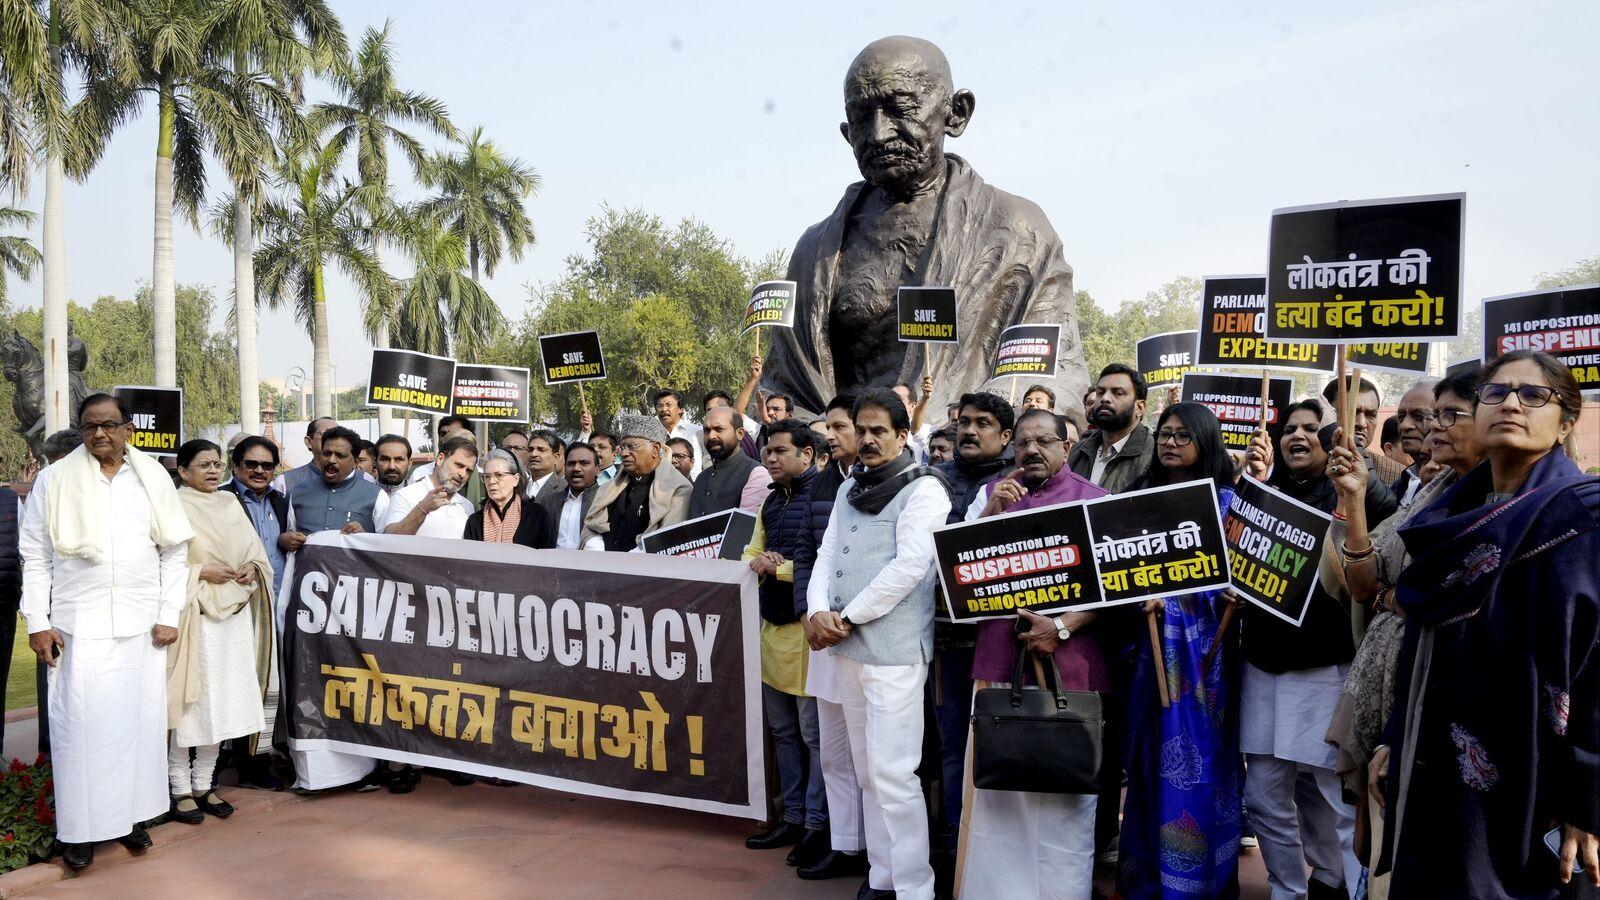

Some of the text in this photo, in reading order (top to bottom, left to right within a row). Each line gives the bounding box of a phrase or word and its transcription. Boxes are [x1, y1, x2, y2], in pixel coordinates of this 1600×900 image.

[1286, 248, 1431, 290] लोकतंत्र की
[1213, 294, 1266, 309] PARLIAM
[1275, 289, 1445, 329] हत्या बंद करो!
[914, 309, 937, 323] SAVE
[901, 322, 953, 338] DEMOCRACY
[1503, 322, 1521, 334] 141
[562, 351, 585, 365] SAVE
[1159, 352, 1191, 367] SAVE
[1218, 337, 1319, 363] EXPELLED!
[548, 362, 601, 379] DEMOCRACY
[397, 373, 428, 391] SAVE
[456, 386, 519, 399] SUSPENDED
[467, 380, 504, 388] OPPOSITION
[373, 386, 448, 409] DEMOCRACY
[1204, 393, 1254, 405] OPPOSITION
[132, 413, 156, 430] AVE
[1169, 520, 1203, 550] की
[1274, 520, 1317, 552] CAGED
[667, 537, 710, 556] OPPOSITION
[957, 534, 1070, 563] 141 OPPOSITION MPs
[958, 546, 1077, 583] SUSPENDED
[1130, 560, 1164, 588] बंद
[1164, 550, 1220, 582] करो!
[1228, 547, 1289, 603] PELLED!
[973, 572, 1069, 597] IS THIS MOTHER OF
[296, 570, 722, 684] SAVE DEMOCRACY
[320, 653, 501, 746] लोकतंत्र
[509, 690, 670, 772] बचाओ
